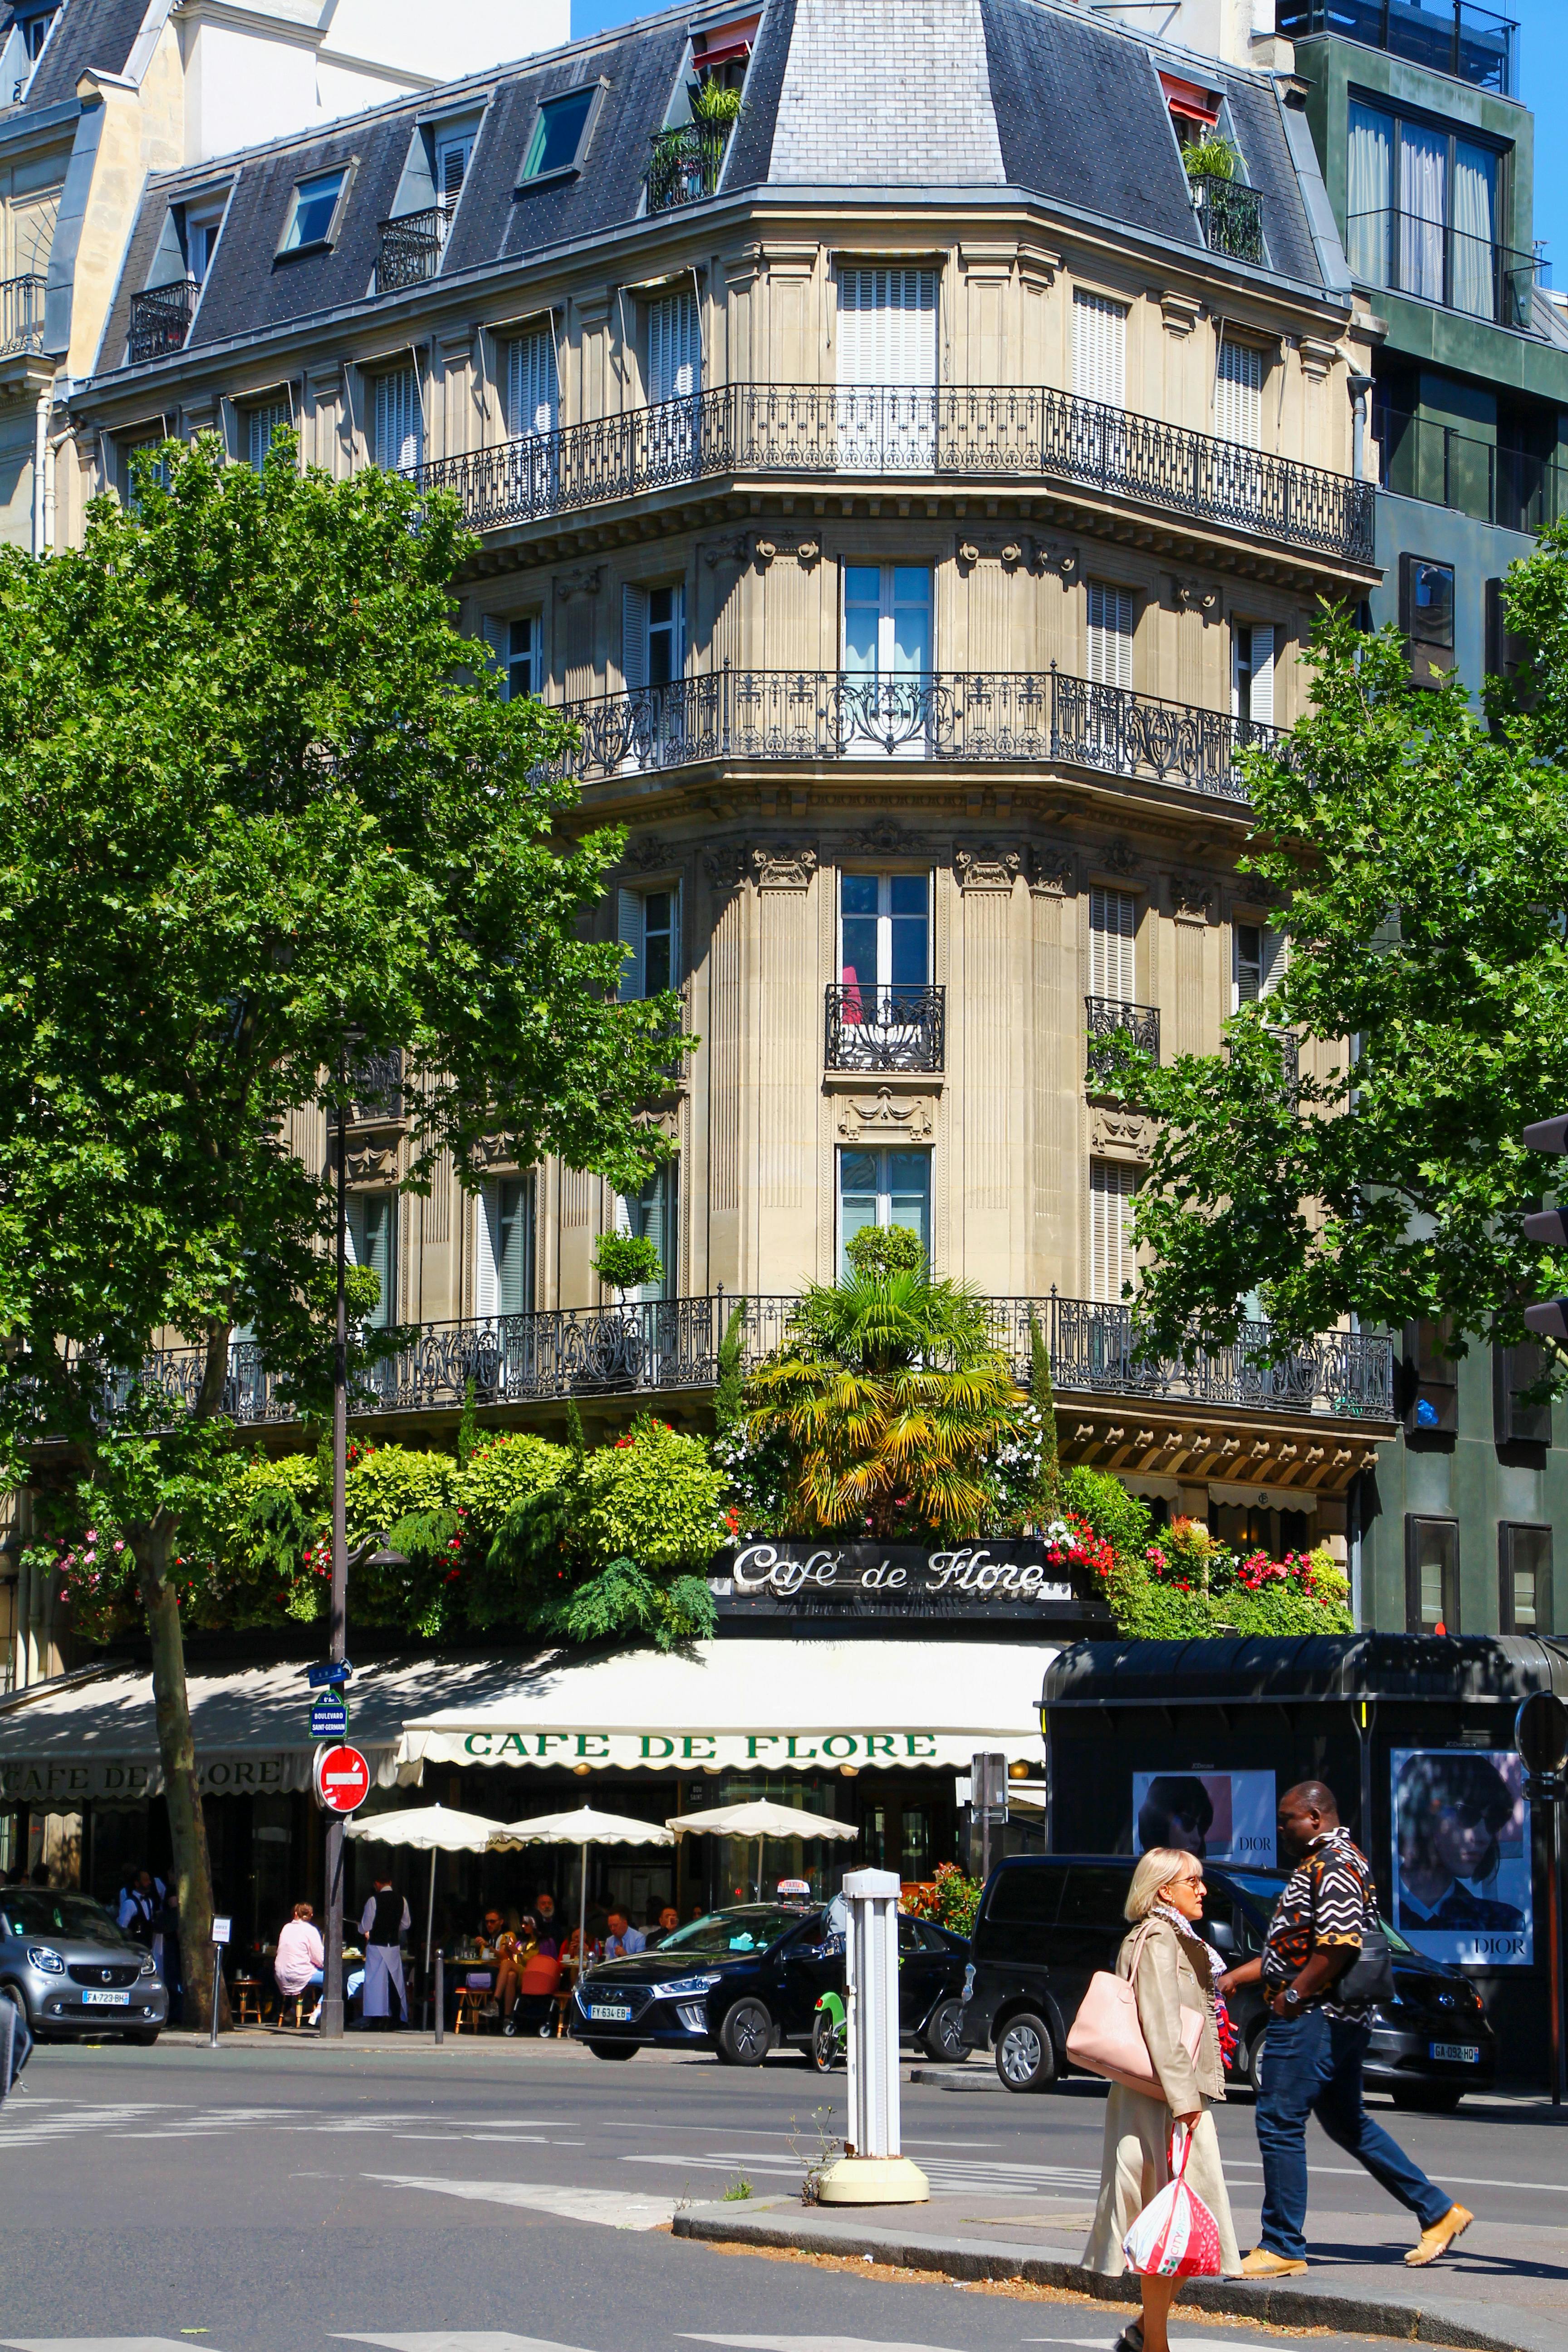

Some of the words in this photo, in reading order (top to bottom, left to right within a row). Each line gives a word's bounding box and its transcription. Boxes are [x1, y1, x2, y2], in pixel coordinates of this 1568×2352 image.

[732, 1545, 845, 1596] Café
[862, 1560, 907, 1588] de
[925, 1548, 1045, 1590] Flore
[464, 1733, 611, 1757] CAFE
[638, 1735, 717, 1759] DE
[745, 1735, 937, 1759] FLORE
[3, 1768, 89, 1792] CAFE
[105, 1766, 149, 1788] DE
[198, 1761, 280, 1785] ORE
[1240, 1837, 1272, 1851] DIOR
[1474, 1938, 1526, 1955] DIOR
[88, 1994, 124, 2003] FA-723-BH
[592, 2007, 626, 2018] FY-634-EB
[1435, 2045, 1474, 2060] GA-092-HQ
